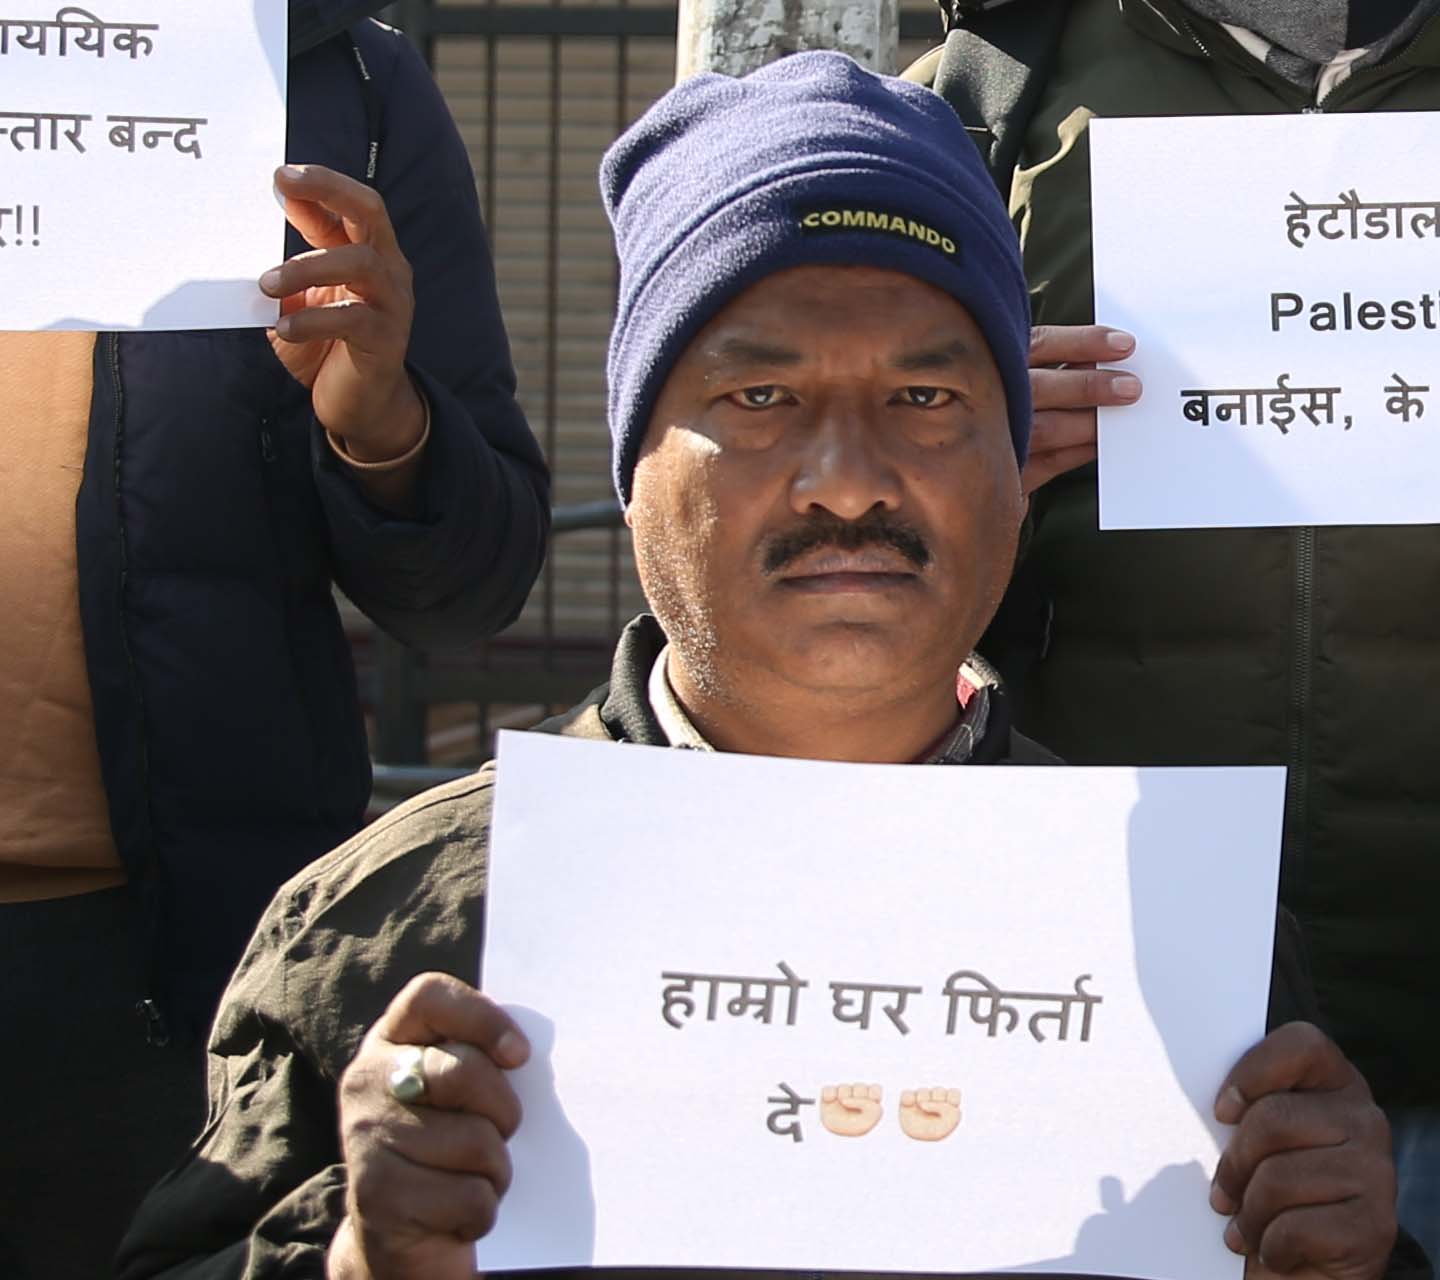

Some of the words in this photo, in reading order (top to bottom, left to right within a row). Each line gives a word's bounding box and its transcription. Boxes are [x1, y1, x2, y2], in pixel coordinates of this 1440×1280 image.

[107, 116, 207, 159] बन्द
[802, 210, 956, 254] COMMANDO
[1180, 374, 1352, 434] बनाईस,
[1384, 373, 1429, 422] के
[662, 962, 808, 1029] हाम्रो
[829, 982, 922, 1035] घर
[942, 971, 1102, 1042] फिर्ता
[767, 1084, 814, 1142] दे
